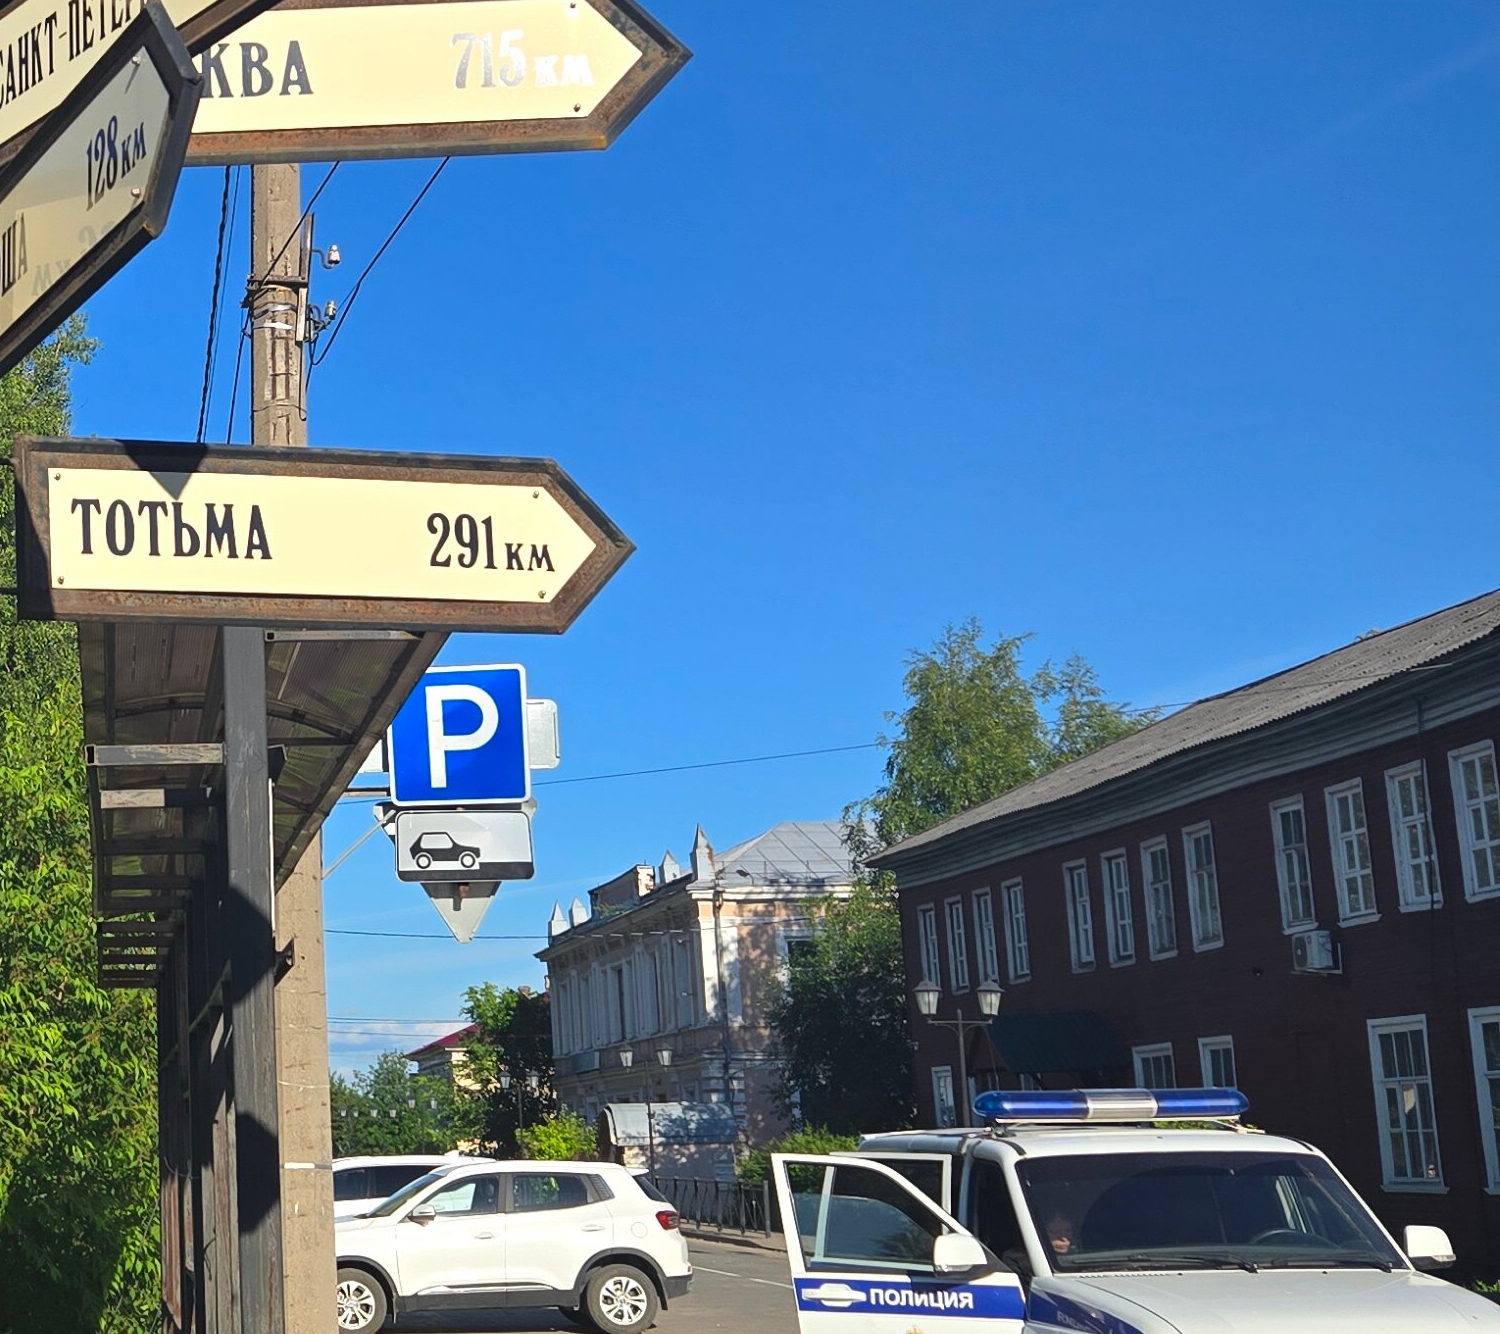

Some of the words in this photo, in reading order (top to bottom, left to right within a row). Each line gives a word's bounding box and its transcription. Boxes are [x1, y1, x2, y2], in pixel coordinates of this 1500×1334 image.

[200, 40, 314, 98] КВА
[70, 497, 273, 560] ТОТЬМА
[425, 684, 499, 788] P
[870, 1288, 974, 1310] ПОЛИЦИЯ
